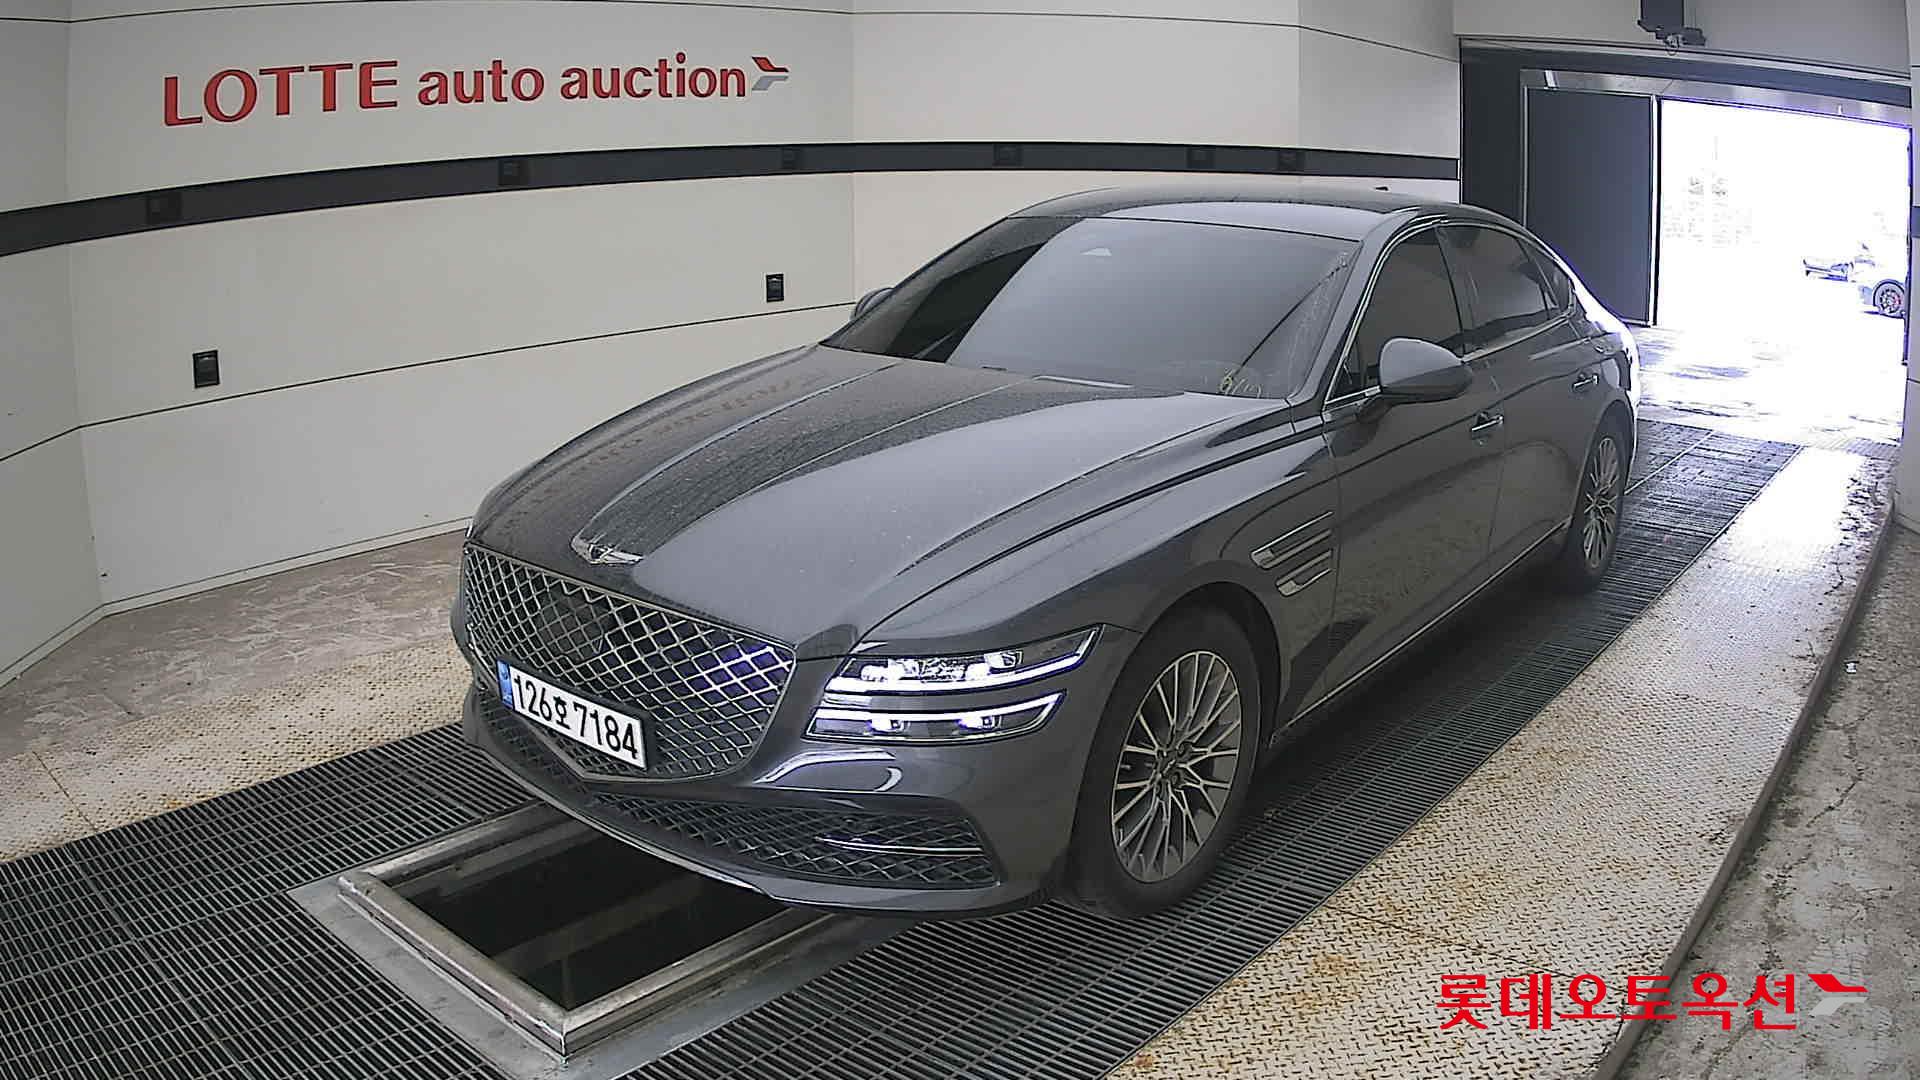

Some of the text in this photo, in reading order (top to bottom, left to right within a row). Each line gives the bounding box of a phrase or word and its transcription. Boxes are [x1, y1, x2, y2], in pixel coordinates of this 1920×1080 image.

[163, 52, 748, 127] LOTTE auto auction
